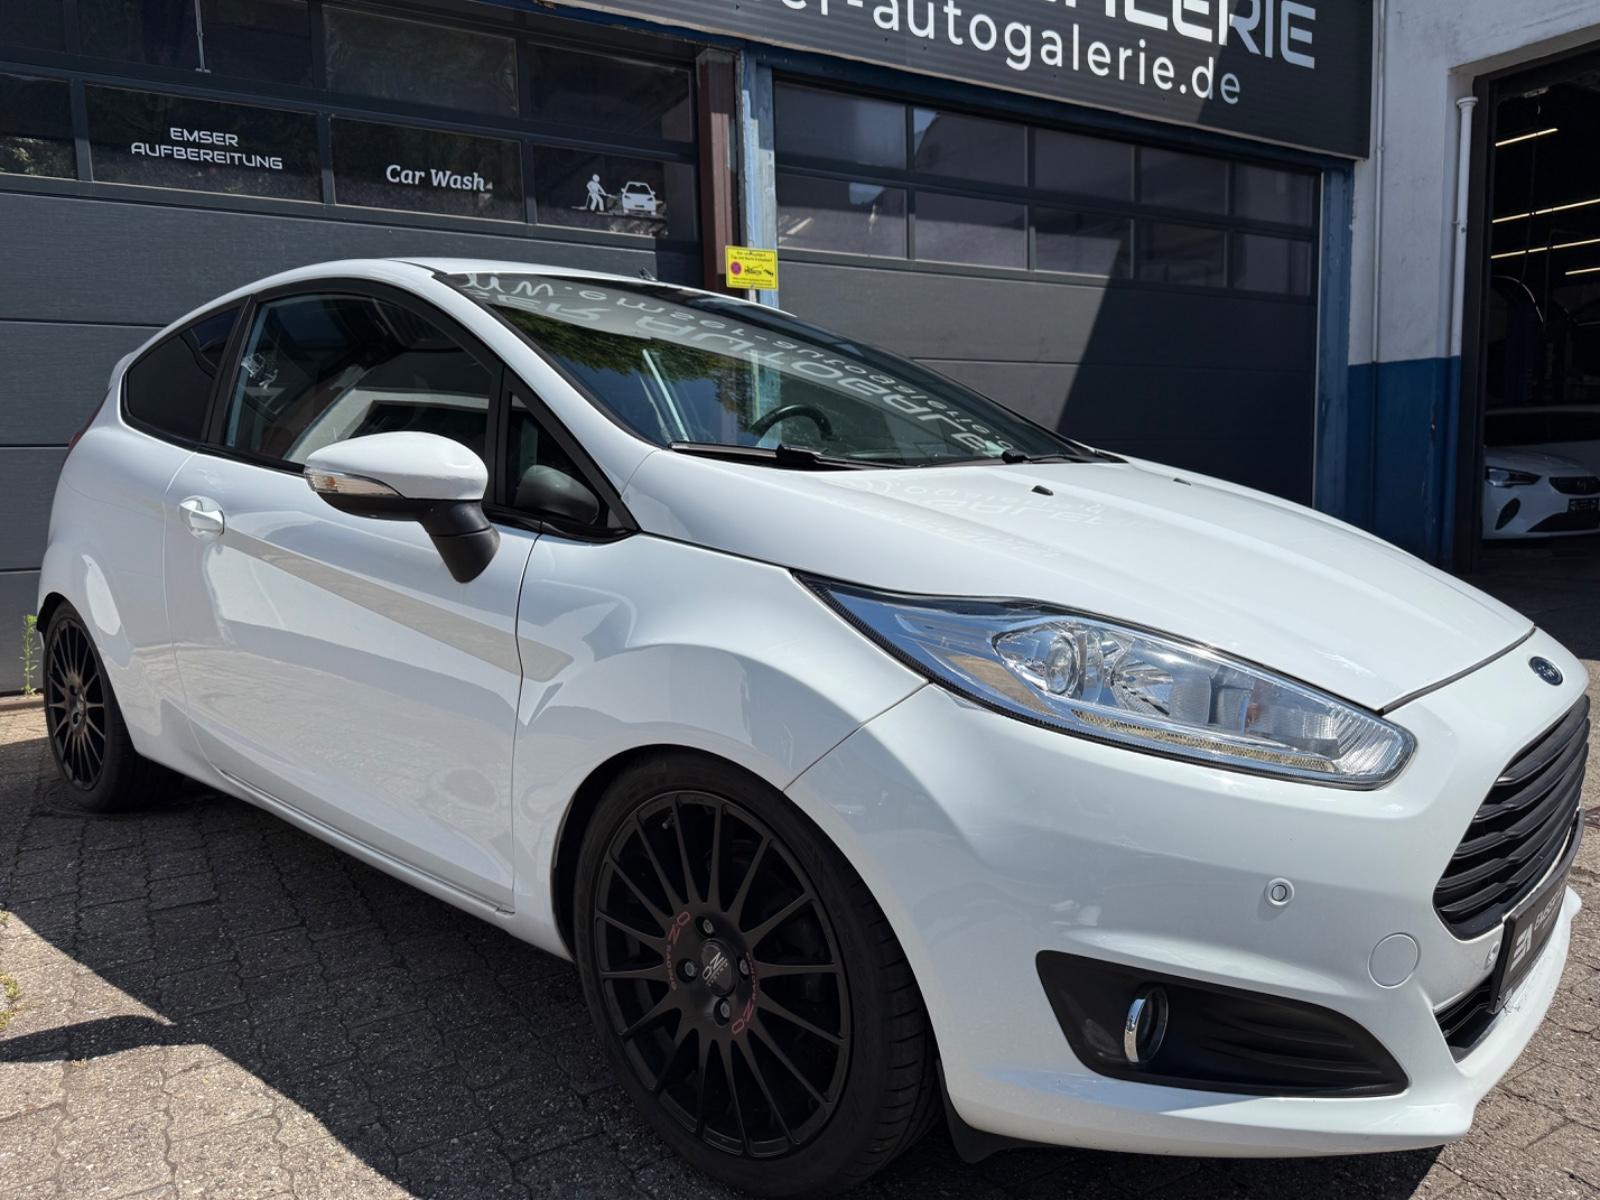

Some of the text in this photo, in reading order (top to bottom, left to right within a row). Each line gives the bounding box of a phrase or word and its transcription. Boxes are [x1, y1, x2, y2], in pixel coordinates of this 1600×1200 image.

[170, 127, 239, 147] EMSER
[131, 142, 284, 170] AUFBEREITUNG
[386, 164, 486, 192] Car Wash
